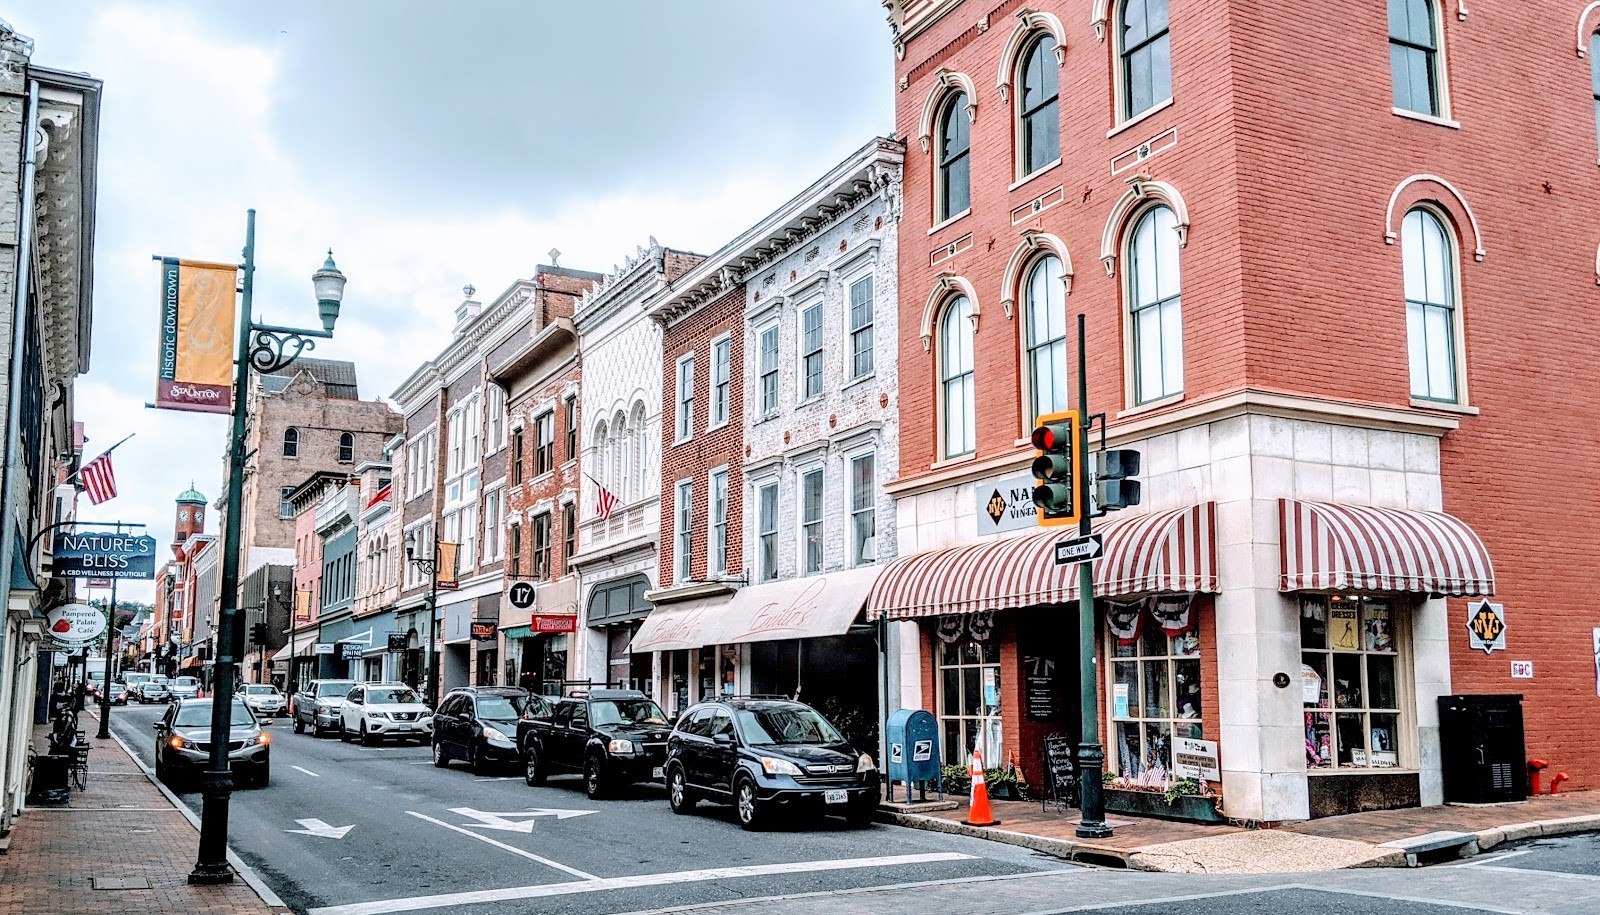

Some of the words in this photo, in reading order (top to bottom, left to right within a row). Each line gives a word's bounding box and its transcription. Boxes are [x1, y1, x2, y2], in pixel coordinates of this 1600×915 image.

[164, 269, 177, 334] downtown
[161, 337, 175, 379] historic
[63, 536, 149, 553] NATURE'S
[1061, 547, 1075, 557] ONE
[1075, 544, 1089, 554] WAY
[83, 553, 129, 568] BLISS
[514, 587, 531, 604] 17
[62, 610, 96, 618] Pampered
[1331, 610, 1356, 619] DRESSES
[77, 626, 94, 634] Café
[1474, 611, 1499, 639] NVJ
